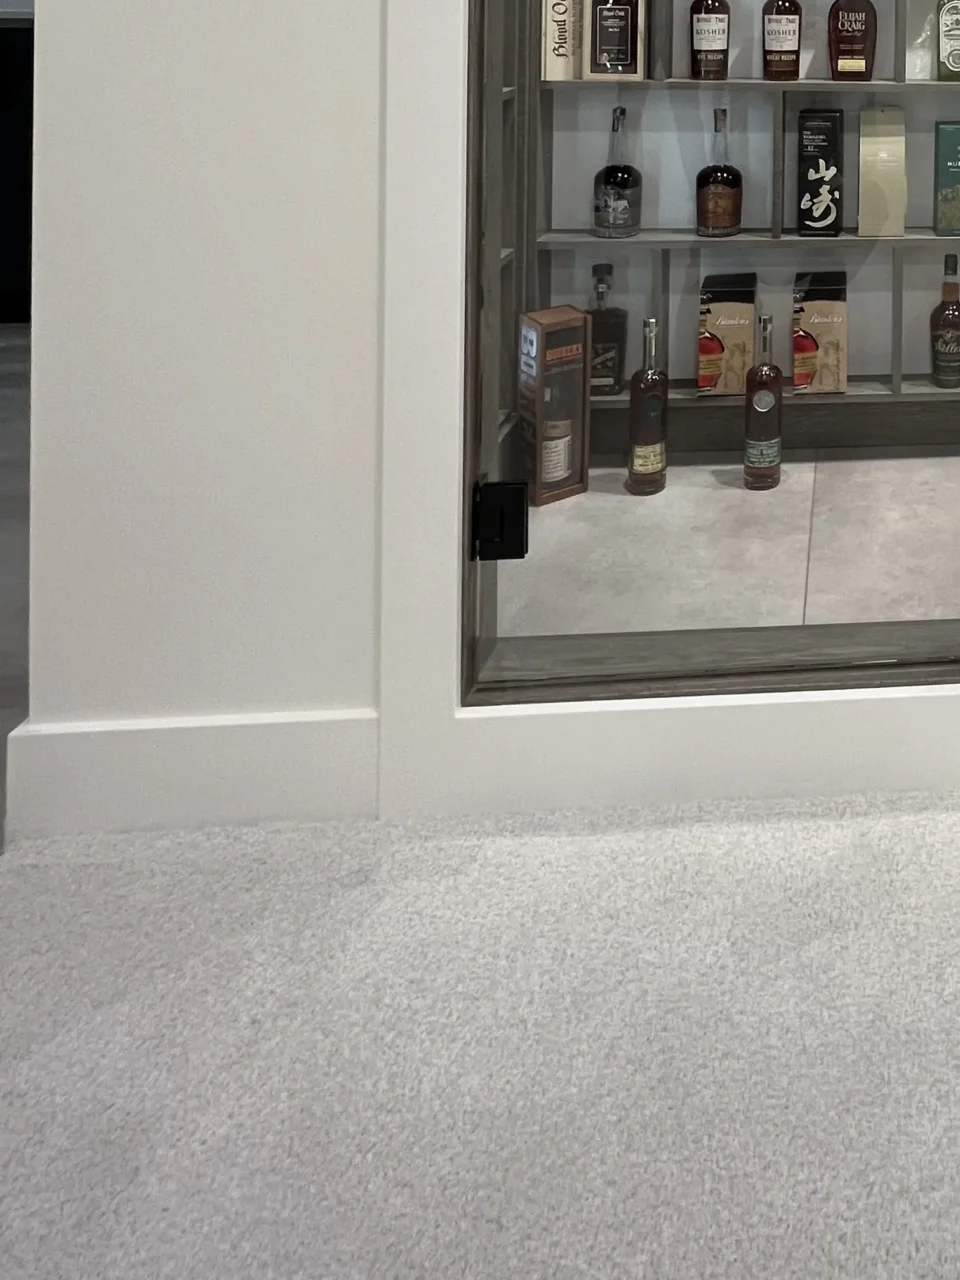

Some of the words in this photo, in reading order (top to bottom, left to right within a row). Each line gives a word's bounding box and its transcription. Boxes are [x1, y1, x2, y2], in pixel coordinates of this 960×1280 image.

[839, 11, 866, 21] ELIJAH
[838, 20, 866, 31] CRAIG
[552, 19, 569, 58] Blood
